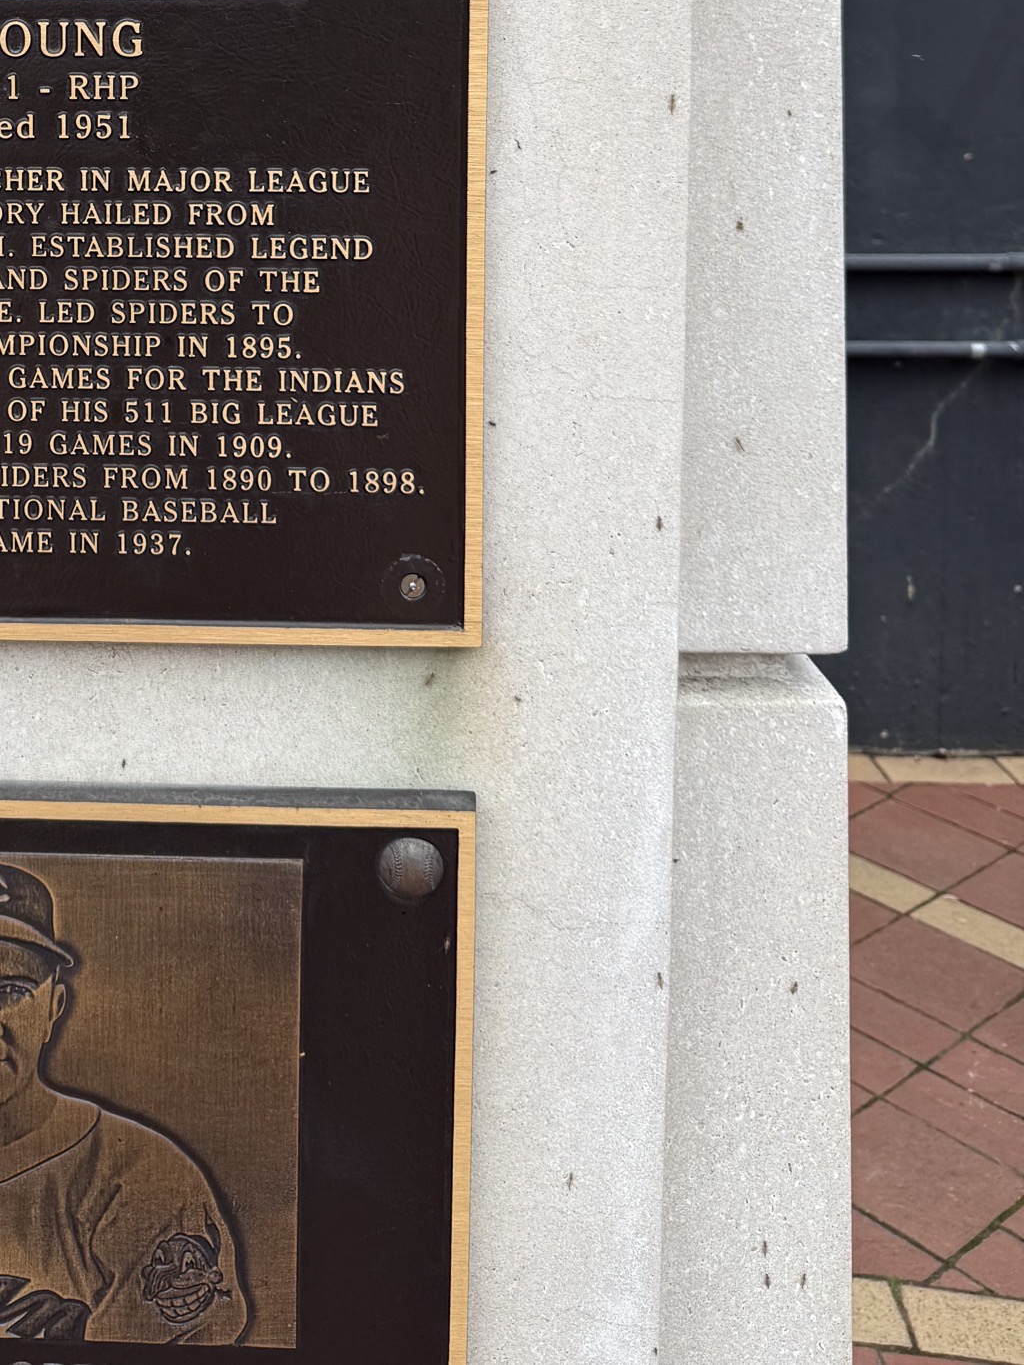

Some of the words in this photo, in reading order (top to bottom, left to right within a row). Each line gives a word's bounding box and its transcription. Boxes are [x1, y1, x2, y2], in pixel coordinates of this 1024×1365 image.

[68, 74, 139, 100] RHP
[58, 113, 129, 140] 1951
[80, 169, 110, 192] IN
[127, 170, 232, 193] MAJOR
[249, 170, 369, 193] LEAGUE
[61, 202, 172, 225] HAILED
[188, 203, 273, 226] FROM
[31, 235, 235, 259] ESTABLISHED
[251, 236, 373, 260] LEGEND
[64, 268, 188, 292] SPIDERS
[204, 269, 244, 293] OF
[259, 270, 320, 294] THE
[39, 301, 95, 324] LED
[111, 302, 236, 326] SPIDERS
[251, 303, 294, 326] TO
[178, 335, 208, 358] IN
[227, 336, 300, 360] 1895.
[8, 366, 111, 390] GAMES
[127, 368, 186, 391] FOR
[201, 368, 262, 392] THE
[279, 370, 405, 395] INDIANS
[7, 399, 46, 422] OF
[61, 400, 108, 423] HIS
[125, 401, 171, 424] 511
[191, 402, 241, 425] BIG
[257, 402, 378, 427] LEAGUE
[5, 432, 33, 455] 19
[49, 432, 152, 457] GAMES
[169, 434, 198, 457] IN
[218, 435, 291, 459] 1909.
[103, 467, 188, 490] FROM
[208, 468, 272, 492] 1890
[288, 469, 330, 493] TO
[350, 470, 425, 495] 1898.
[122, 500, 277, 524] BASEBALL
[70, 531, 98, 554] IN
[118, 532, 191, 556] 1937.
